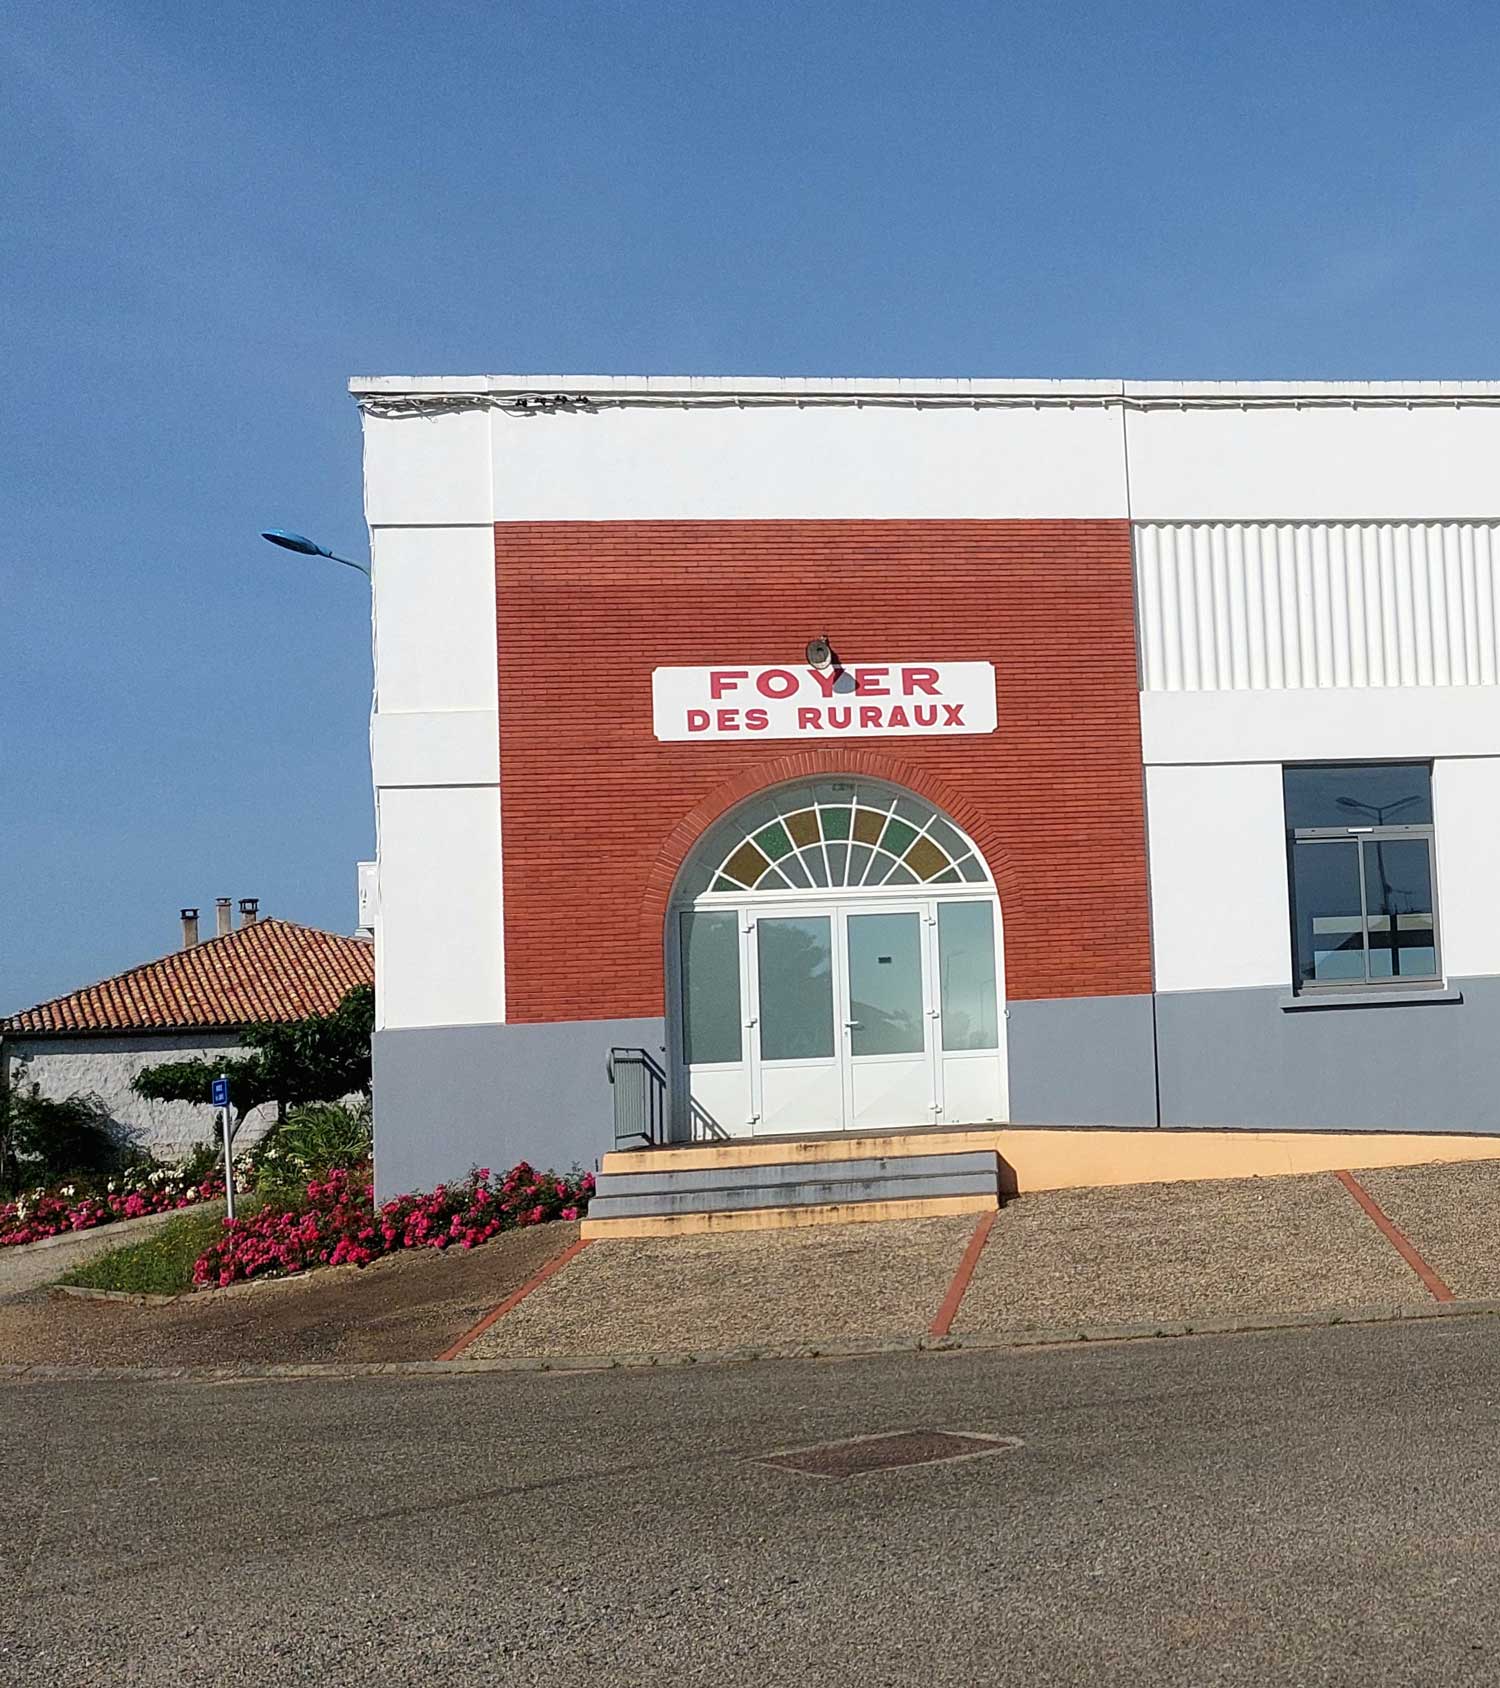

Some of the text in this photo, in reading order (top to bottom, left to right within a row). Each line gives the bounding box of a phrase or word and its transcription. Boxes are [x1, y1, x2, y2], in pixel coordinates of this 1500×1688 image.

[709, 667, 943, 700] FOYER
[687, 704, 965, 732] DES RURAUX
